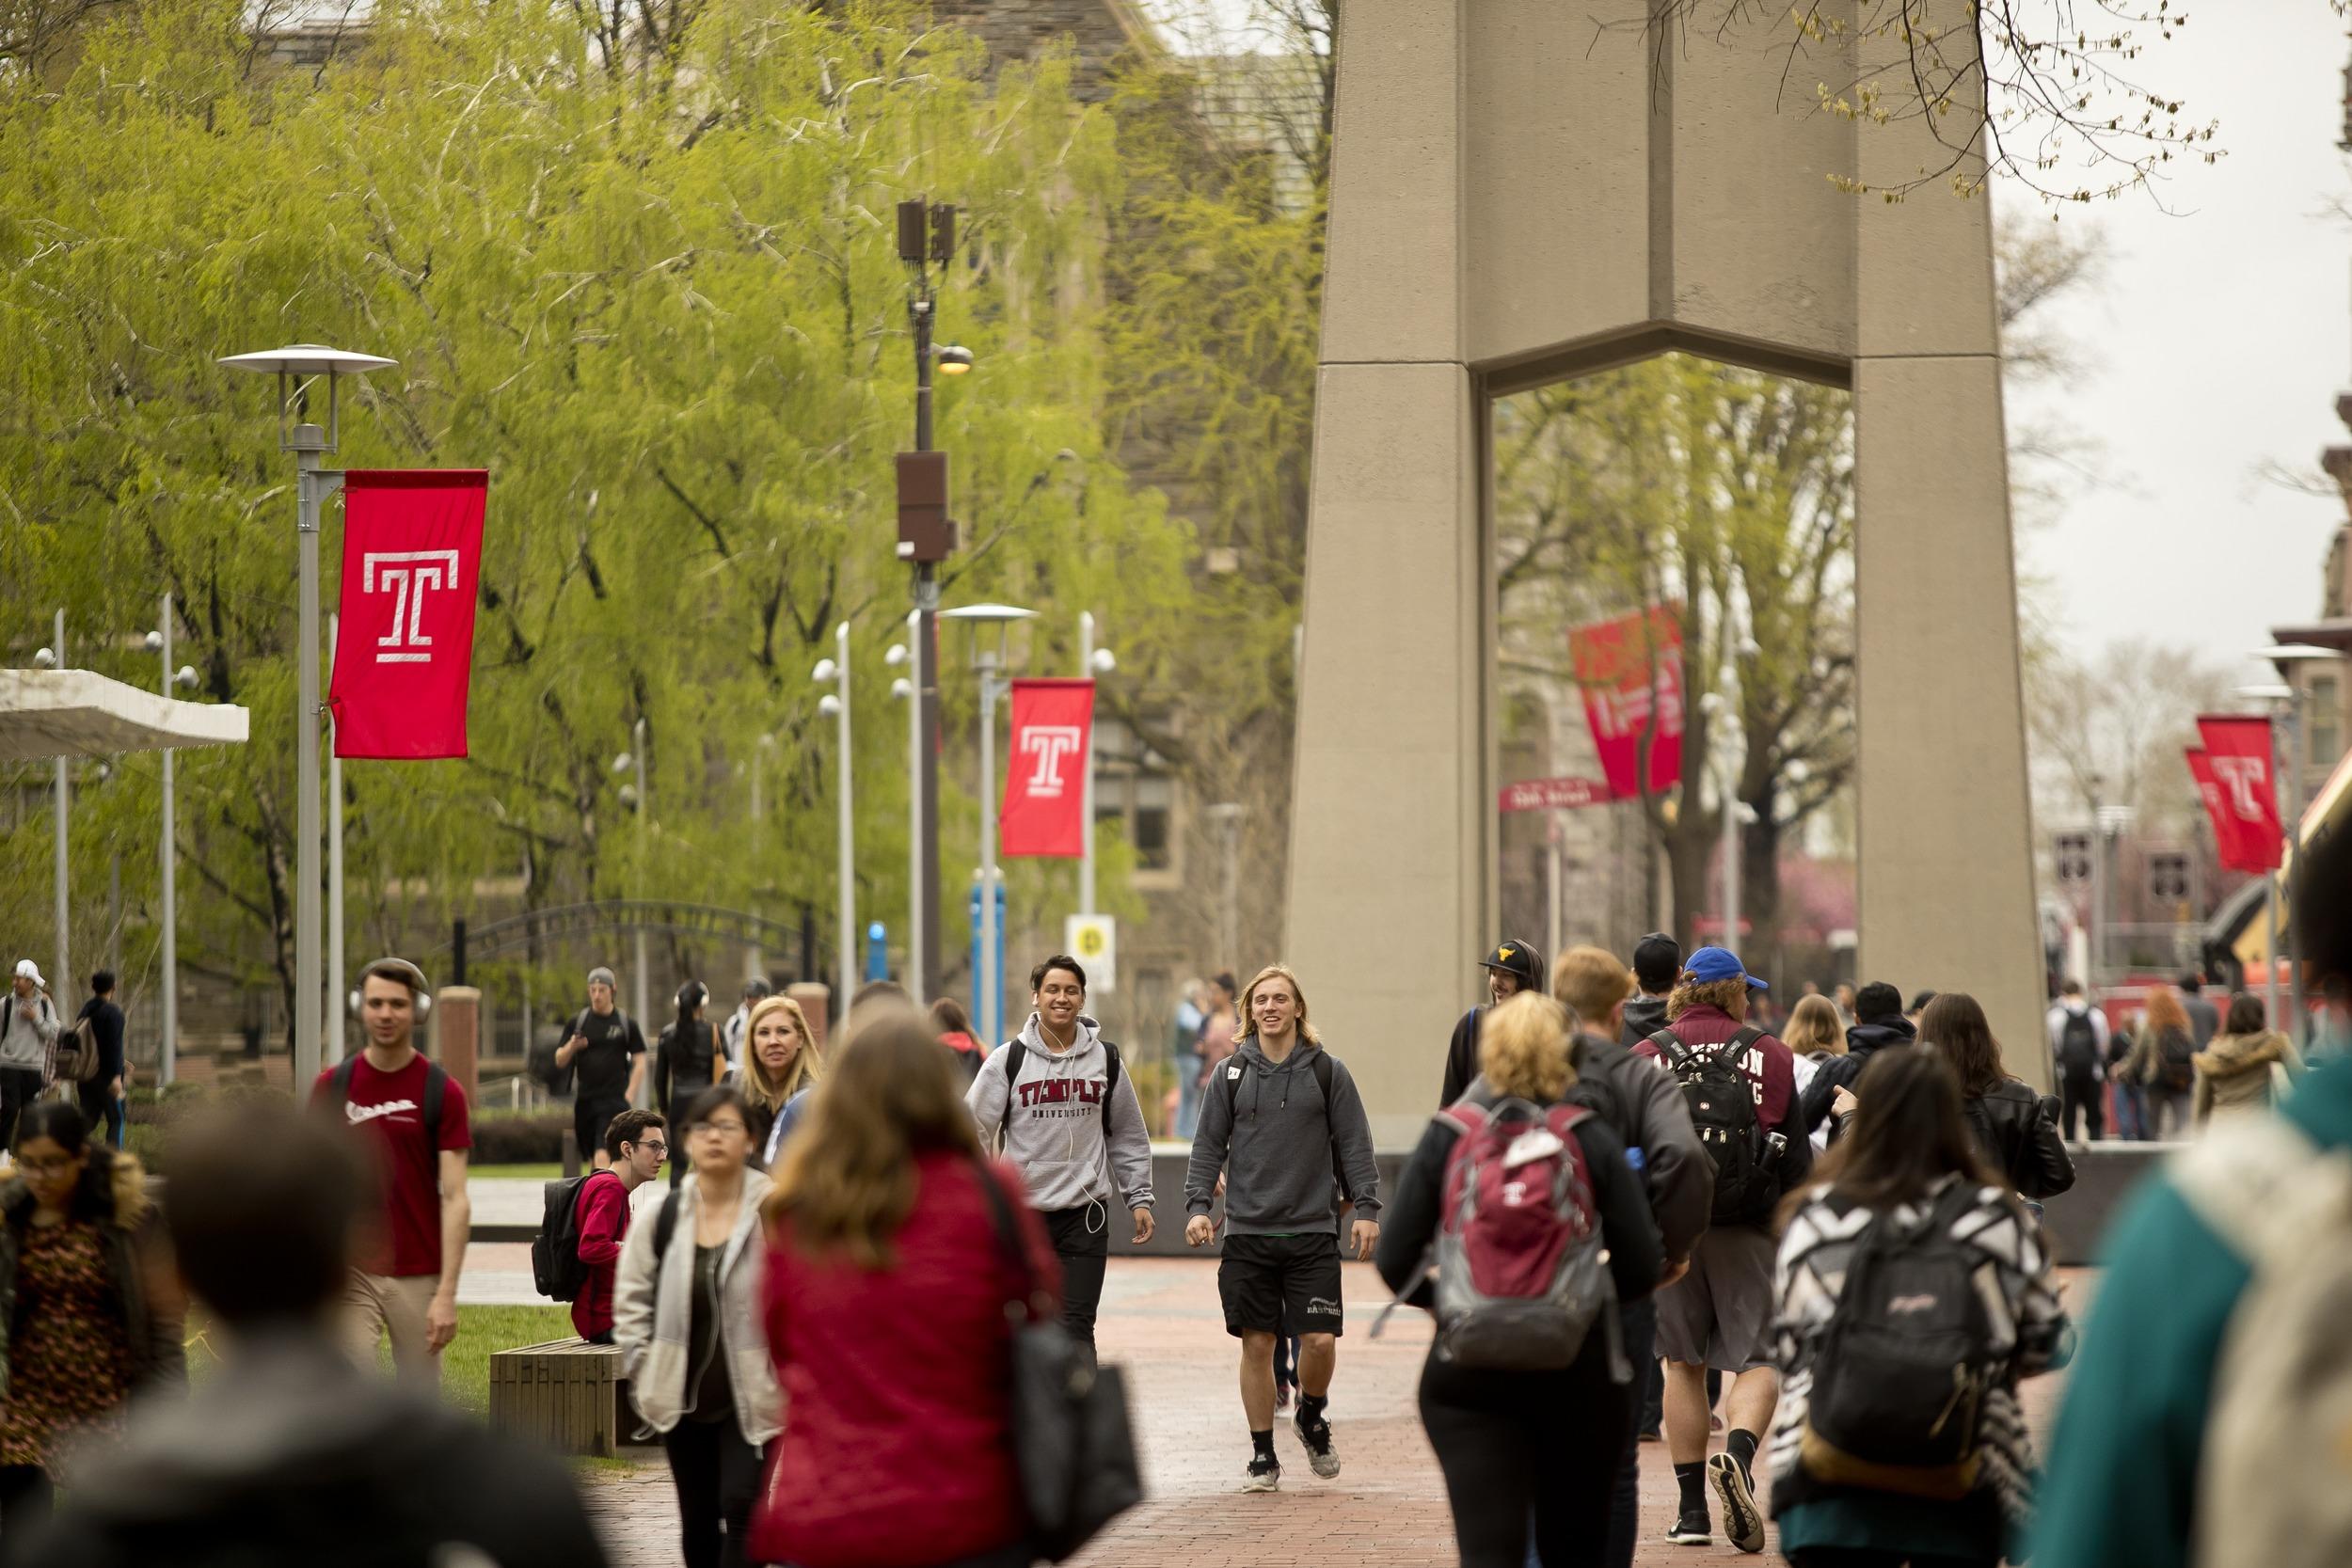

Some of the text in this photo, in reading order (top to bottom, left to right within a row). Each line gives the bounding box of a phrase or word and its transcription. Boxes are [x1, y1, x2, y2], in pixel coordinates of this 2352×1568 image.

[363, 549, 458, 662] T
[1020, 725, 1081, 797] T
[1019, 1079, 1104, 1107] TEMPLE
[1032, 1107, 1091, 1118] UNIVERSITY
